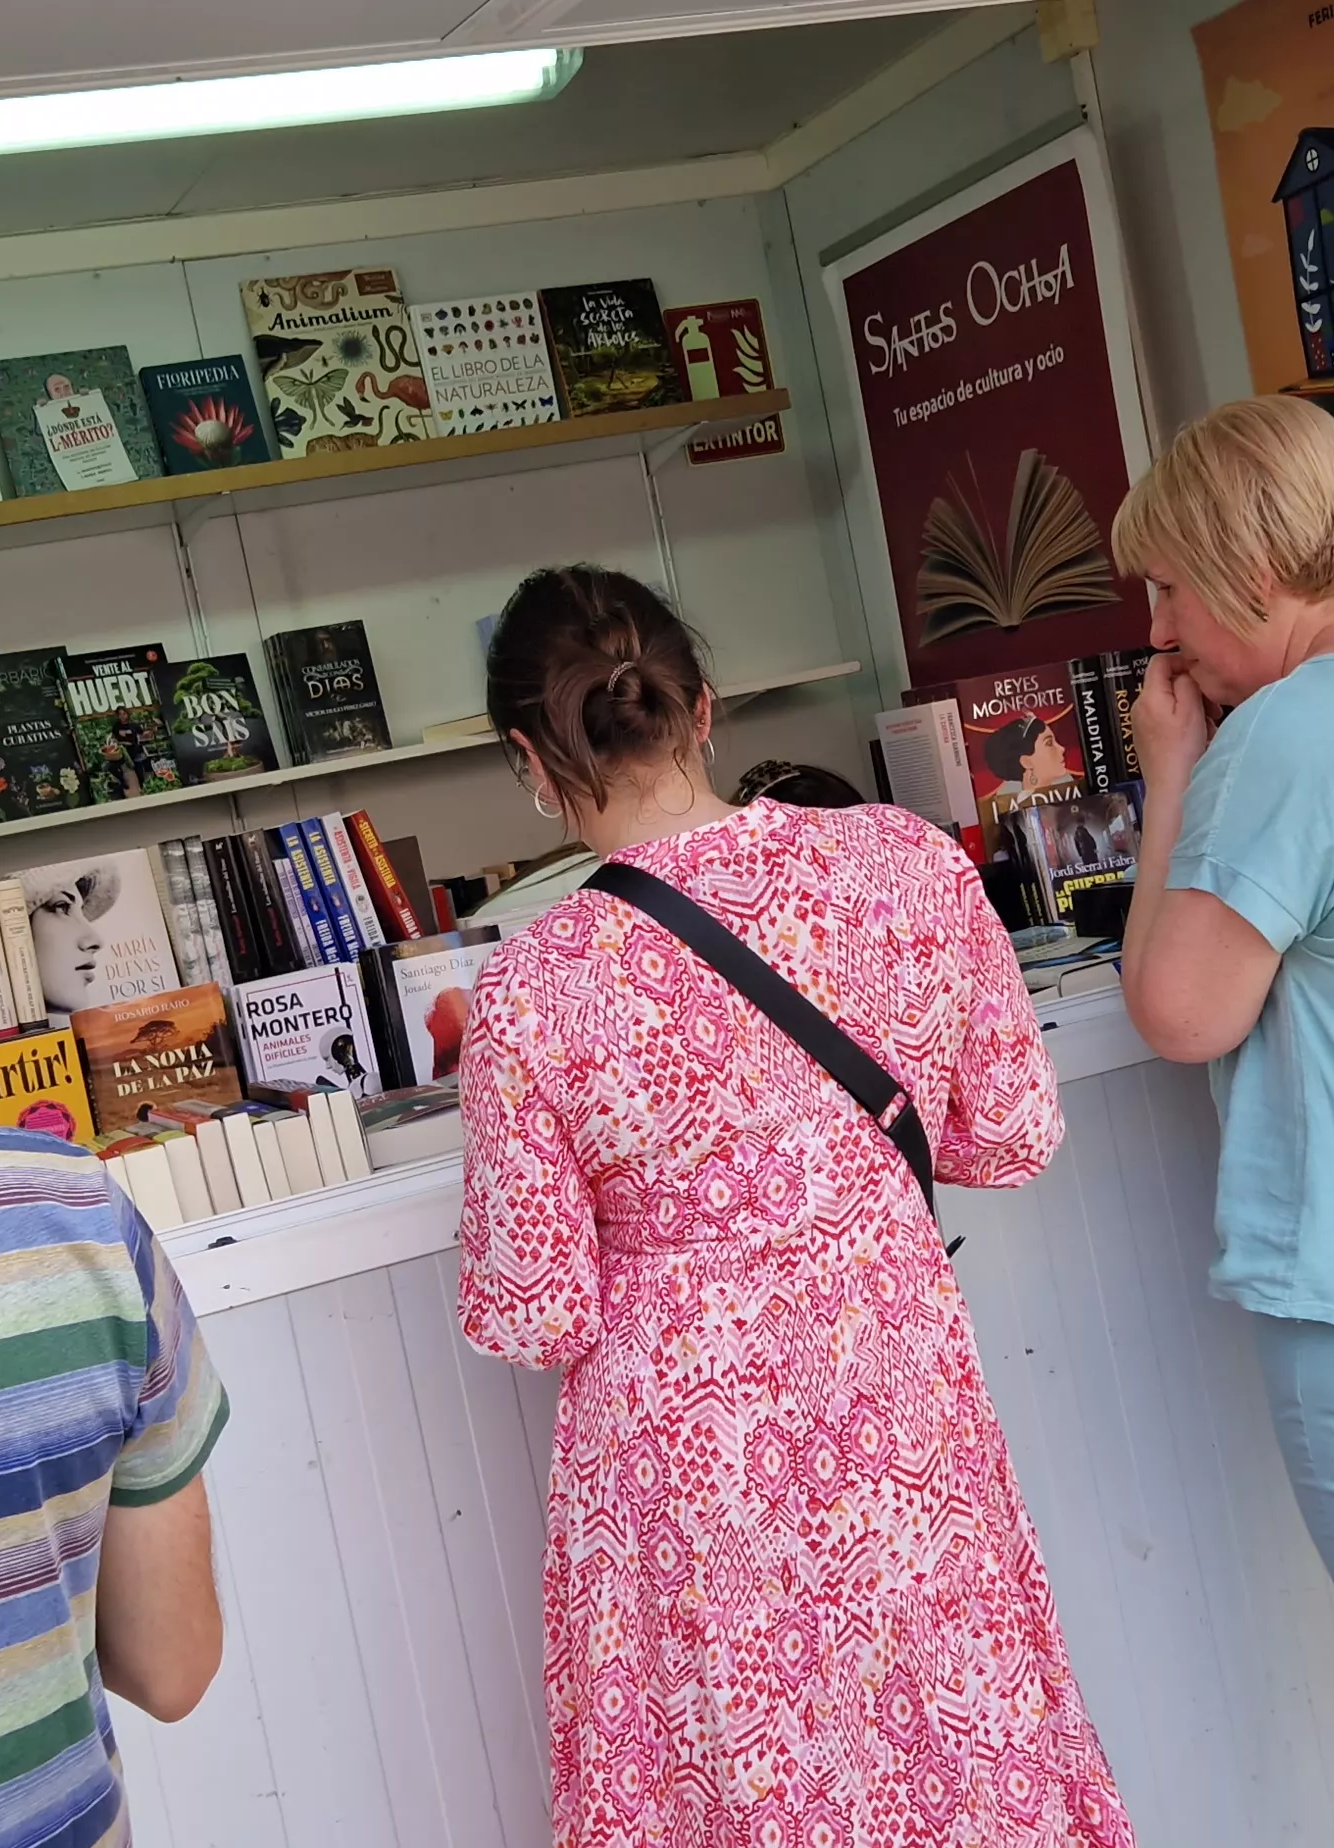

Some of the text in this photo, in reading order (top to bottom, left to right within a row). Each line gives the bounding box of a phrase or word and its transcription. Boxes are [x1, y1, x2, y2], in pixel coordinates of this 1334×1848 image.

[268, 306, 394, 332] Animalium
[430, 353, 545, 382] EL LIBRO DE LA
[434, 376, 550, 404] NATURALEZA
[894, 343, 1064, 428] Tu espacio de cultura y ocio
[48, 412, 102, 436] ¿DÓNDE ESTÁ
[49, 423, 114, 452] L-MÉRITO?
[92, 661, 133, 676] VENTE AL
[308, 674, 364, 699] DIOS
[994, 675, 1039, 698] REYES
[182, 688, 240, 720] BON
[972, 687, 1065, 720] MONFORTE
[3, 730, 62, 747] CURATIVAS
[7, 720, 52, 734] PLANTAS
[1082, 690, 1104, 761] MALDITA
[1116, 690, 1141, 775] ROMA SOY
[286, 835, 300, 848] LA
[291, 849, 315, 890] ASISTENTA
[359, 821, 418, 933] SECRETO ASISTENTA FREIDA
[1049, 855, 1136, 881] Jordi Sierra i Fabra
[309, 831, 356, 943] LA ASISTENTA FREIDA
[347, 868, 362, 890] VIGILA
[363, 916, 378, 944] FREIDA
[110, 934, 157, 958] MARÍA
[315, 919, 335, 947] FREIDA
[105, 960, 161, 981] DUEÑAS
[400, 957, 475, 981] Santiago Díaz
[110, 978, 166, 1000] POR SI
[403, 982, 433, 998] Jotadé
[114, 1000, 190, 1023] ROSARIO RARO
[245, 992, 304, 1020] ROSA
[250, 1003, 353, 1041] MONTERO
[262, 1033, 312, 1052] ANIMALES
[113, 1042, 213, 1079] LA NOVIA
[117, 1060, 217, 1097] DE LA PAZ
